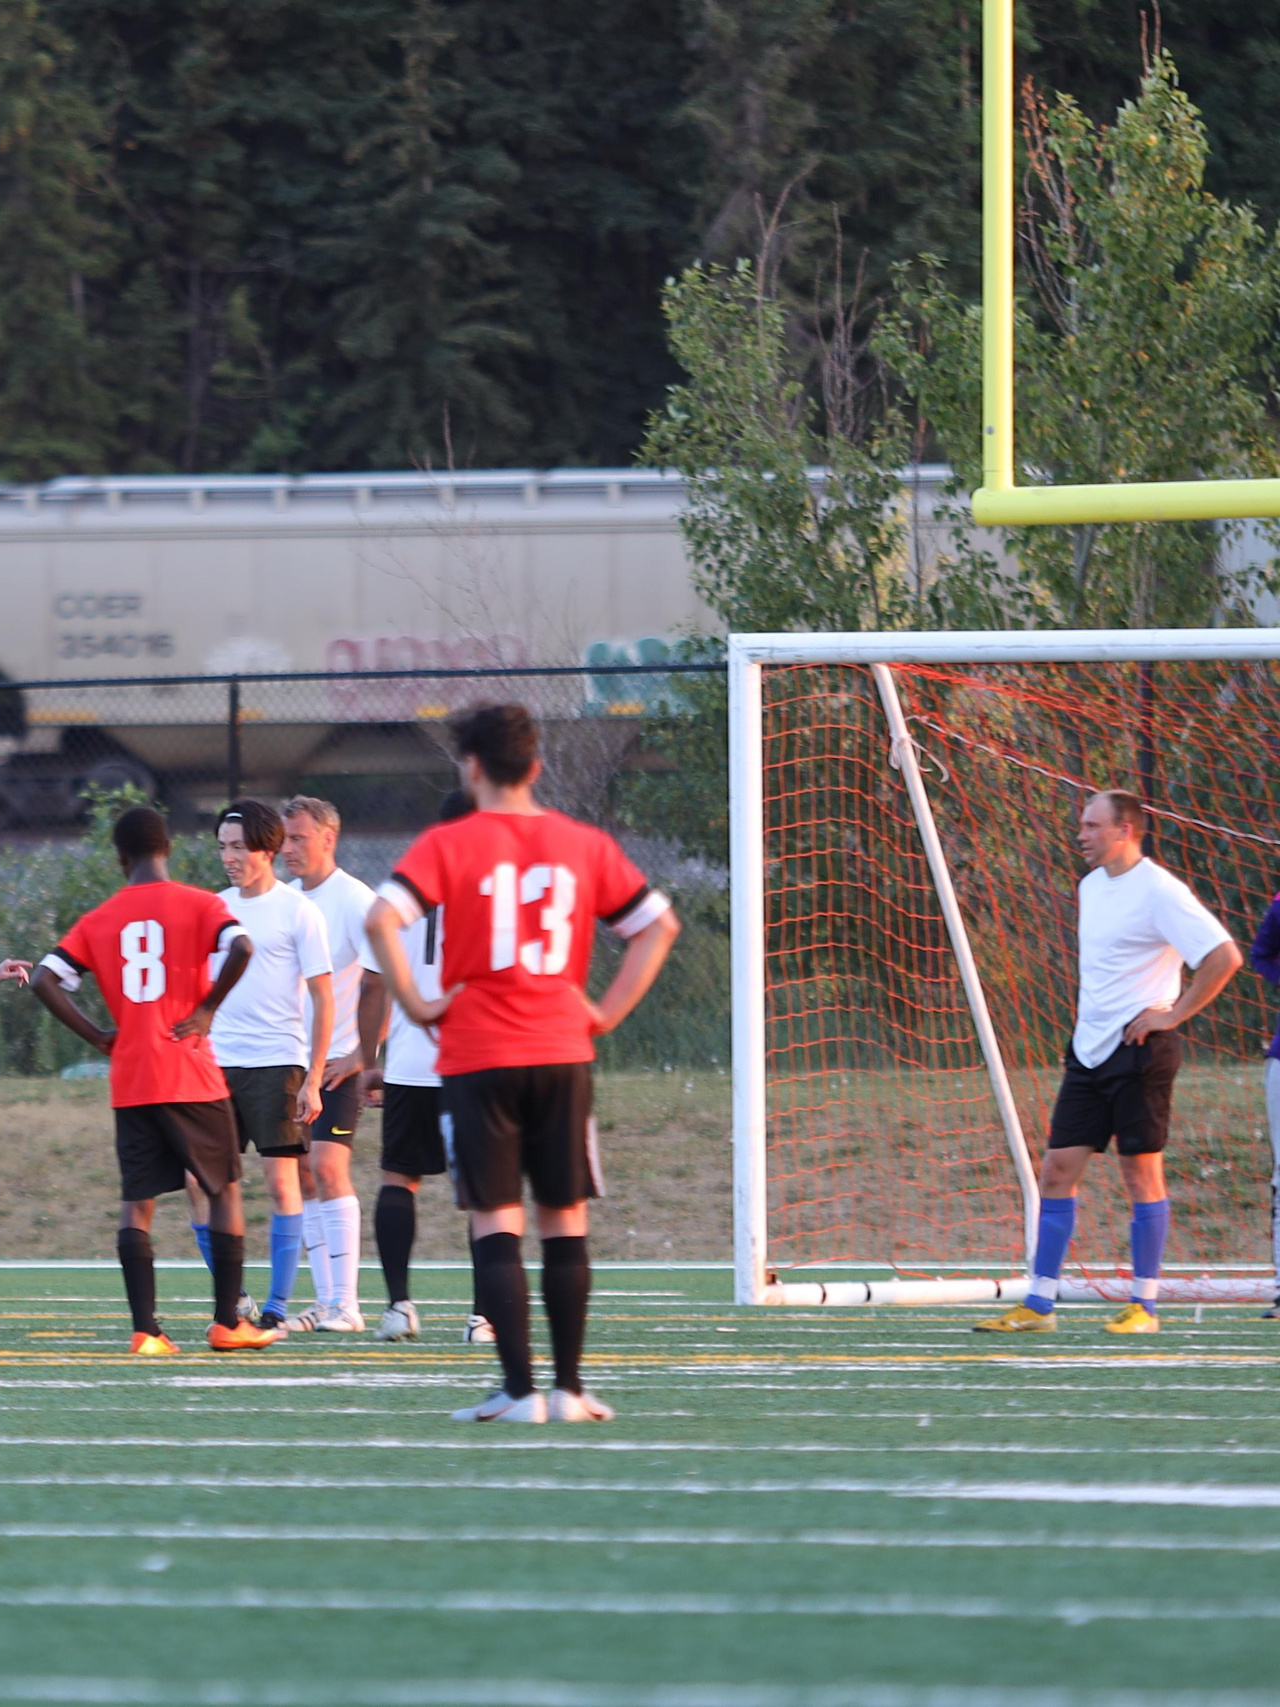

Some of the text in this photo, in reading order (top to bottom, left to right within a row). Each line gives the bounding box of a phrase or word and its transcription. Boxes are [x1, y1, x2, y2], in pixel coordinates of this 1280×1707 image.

[54, 591, 142, 619] COER
[58, 632, 176, 659] 354016
[478, 862, 575, 976] 13
[120, 919, 166, 1004] 8
